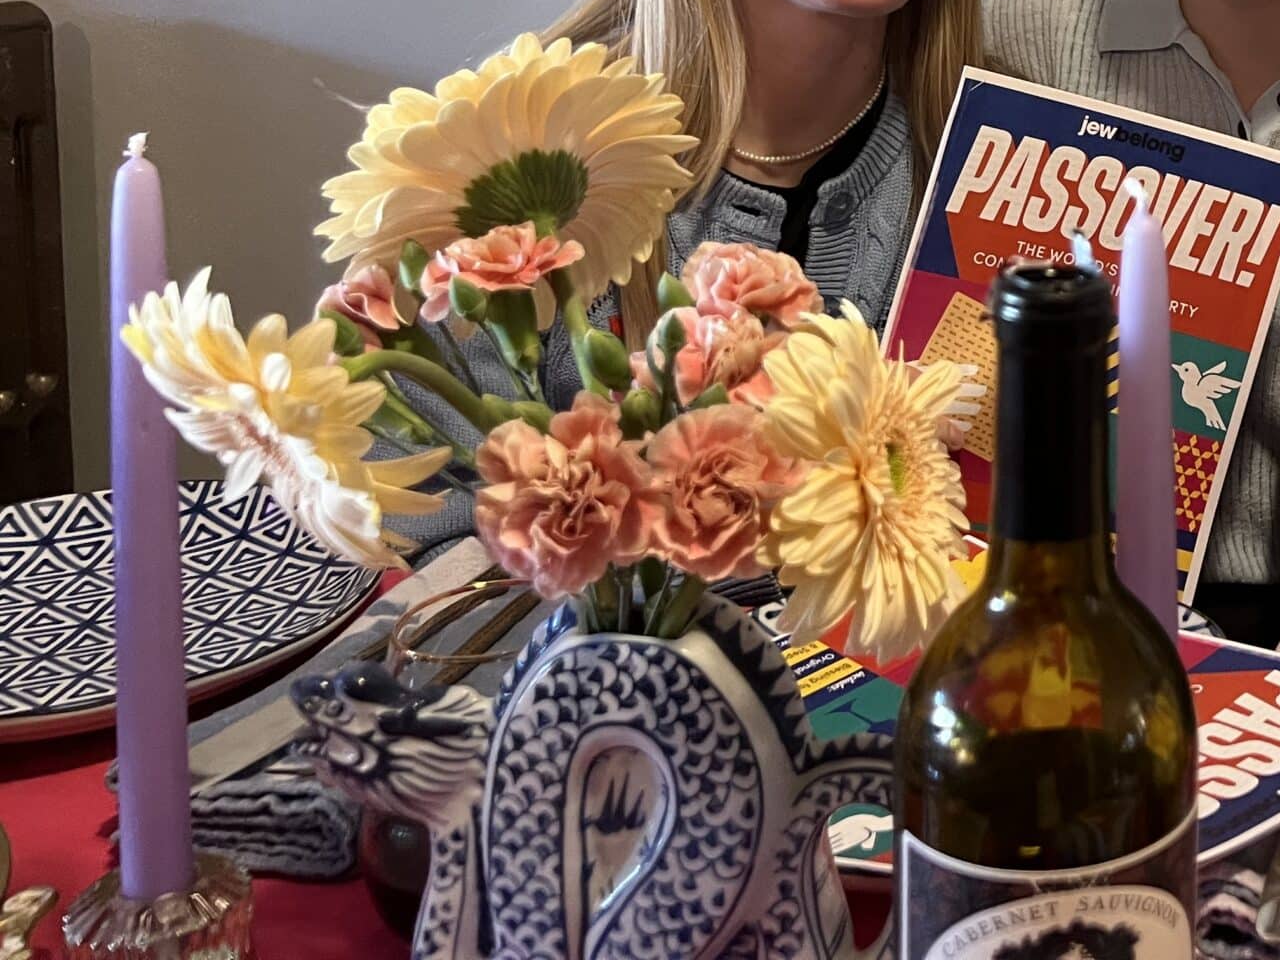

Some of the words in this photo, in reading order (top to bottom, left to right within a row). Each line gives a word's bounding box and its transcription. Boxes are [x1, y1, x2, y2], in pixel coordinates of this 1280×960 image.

[1077, 114, 1186, 163] jewbelong
[1016, 240, 1047, 258] THE
[1049, 249, 1119, 277] WOD'S
[1168, 300, 1199, 318] RTY
[942, 900, 1060, 959] CABERNET
[1074, 893, 1181, 929] SAUVIGNON
